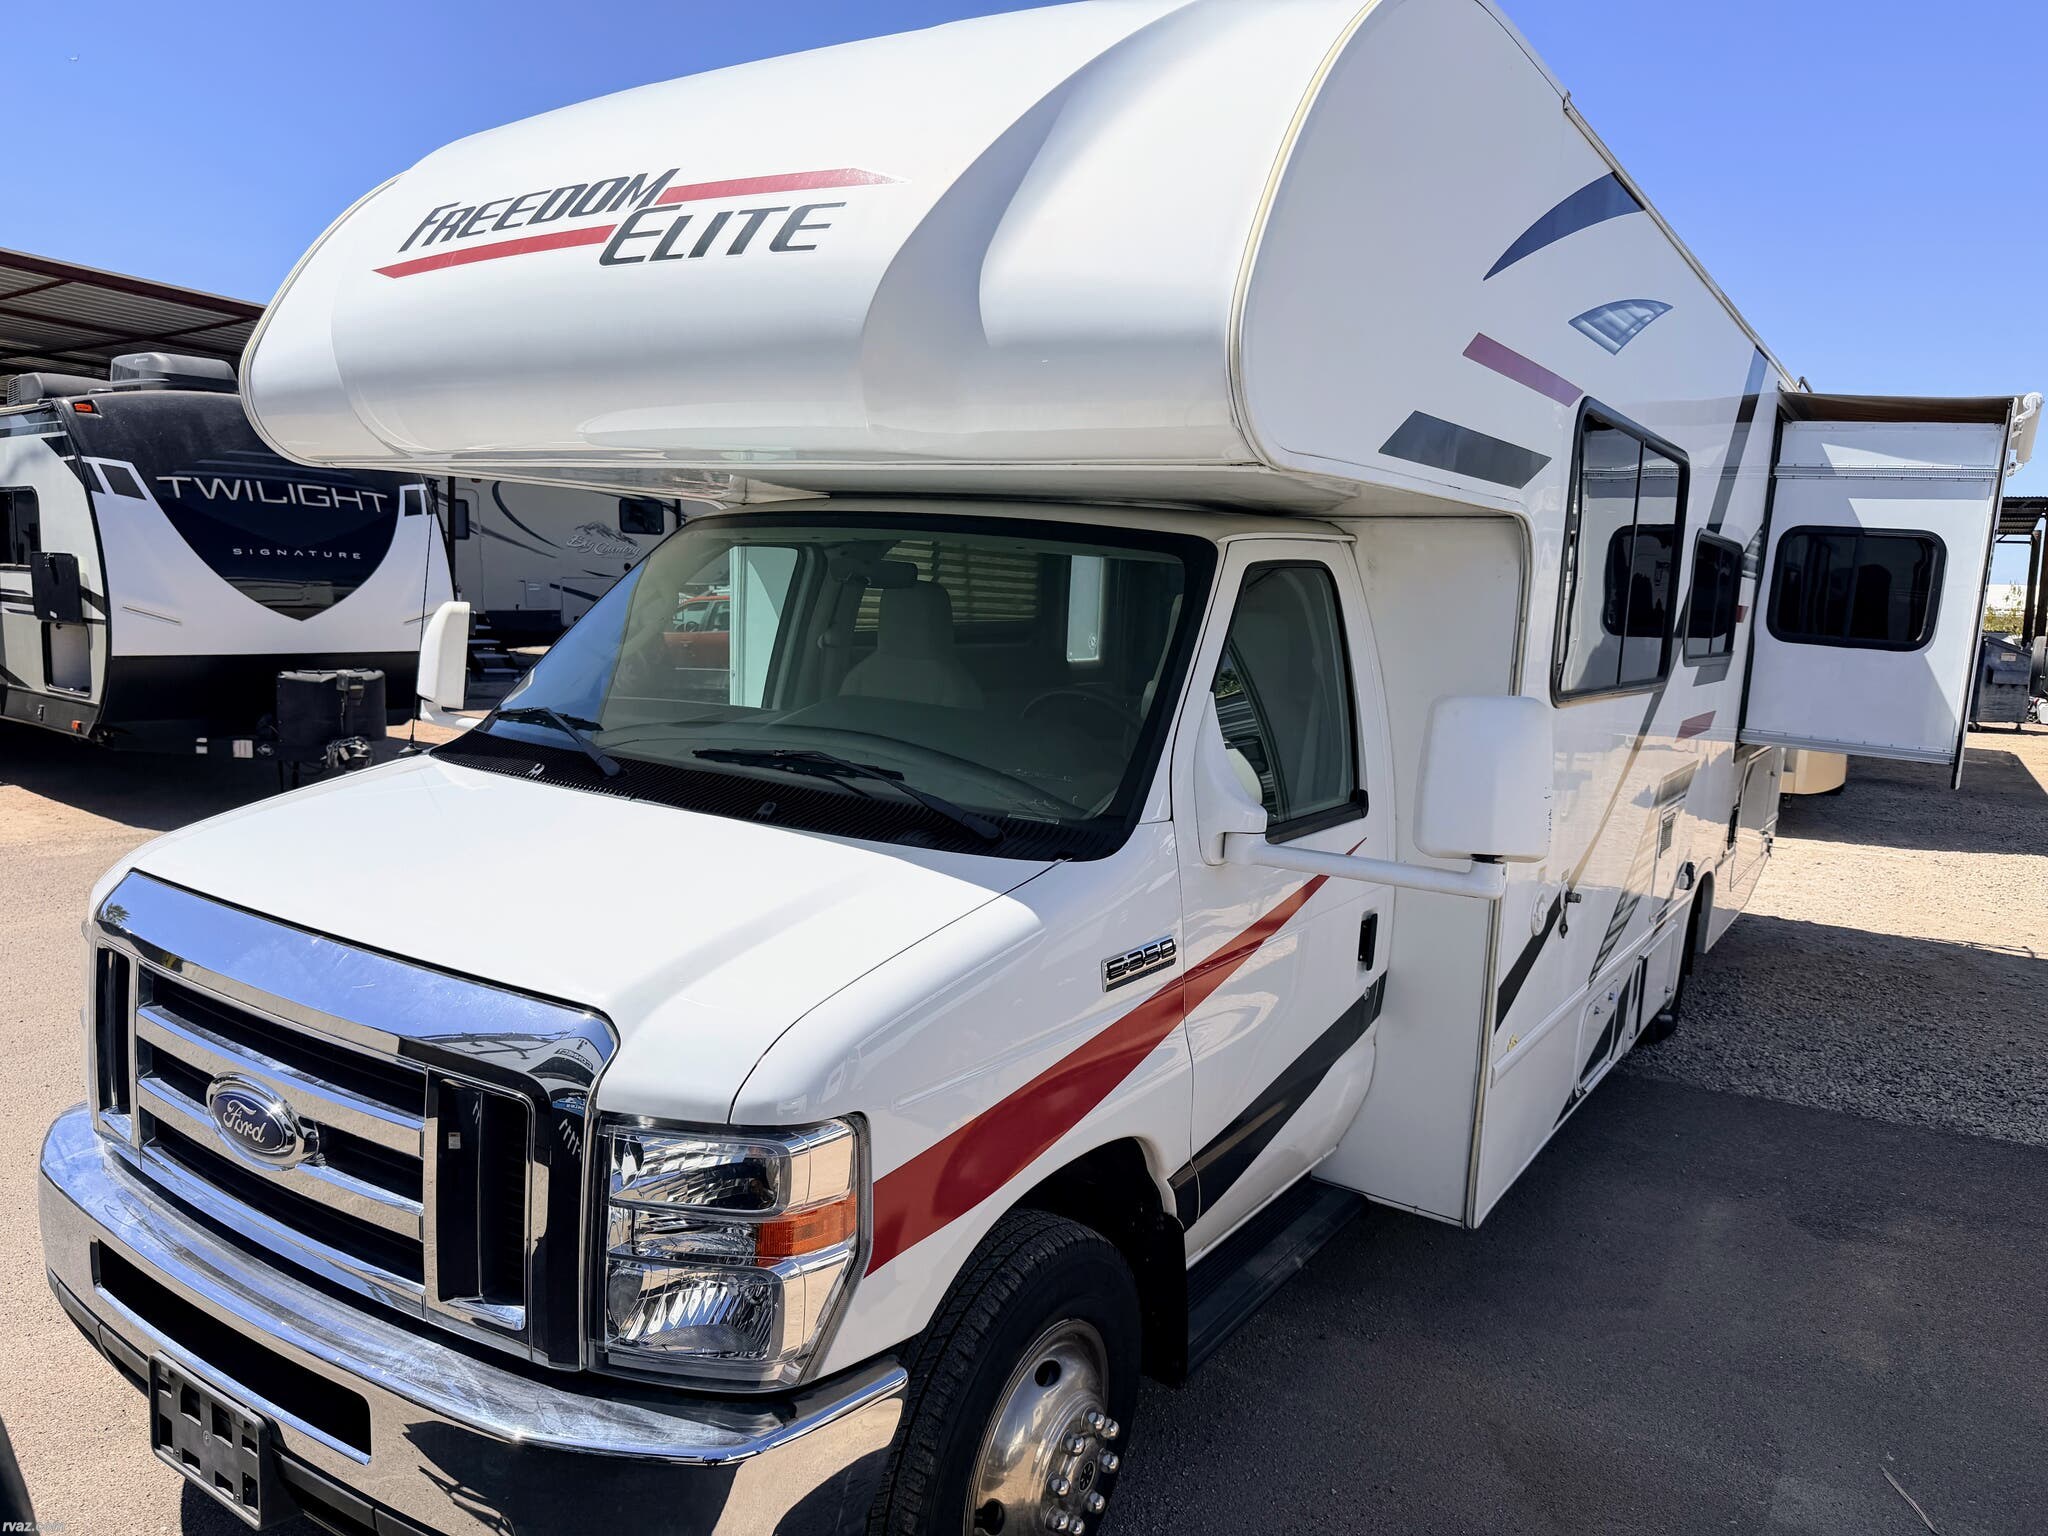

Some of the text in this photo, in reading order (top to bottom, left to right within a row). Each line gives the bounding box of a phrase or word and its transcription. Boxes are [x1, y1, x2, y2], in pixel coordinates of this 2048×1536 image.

[398, 168, 680, 254] FREEDOM
[599, 202, 847, 267] ELITE
[156, 475, 388, 513] TWILIGHT
[232, 547, 362, 560] SIGNATURE
[223, 1099, 268, 1143] Ford
